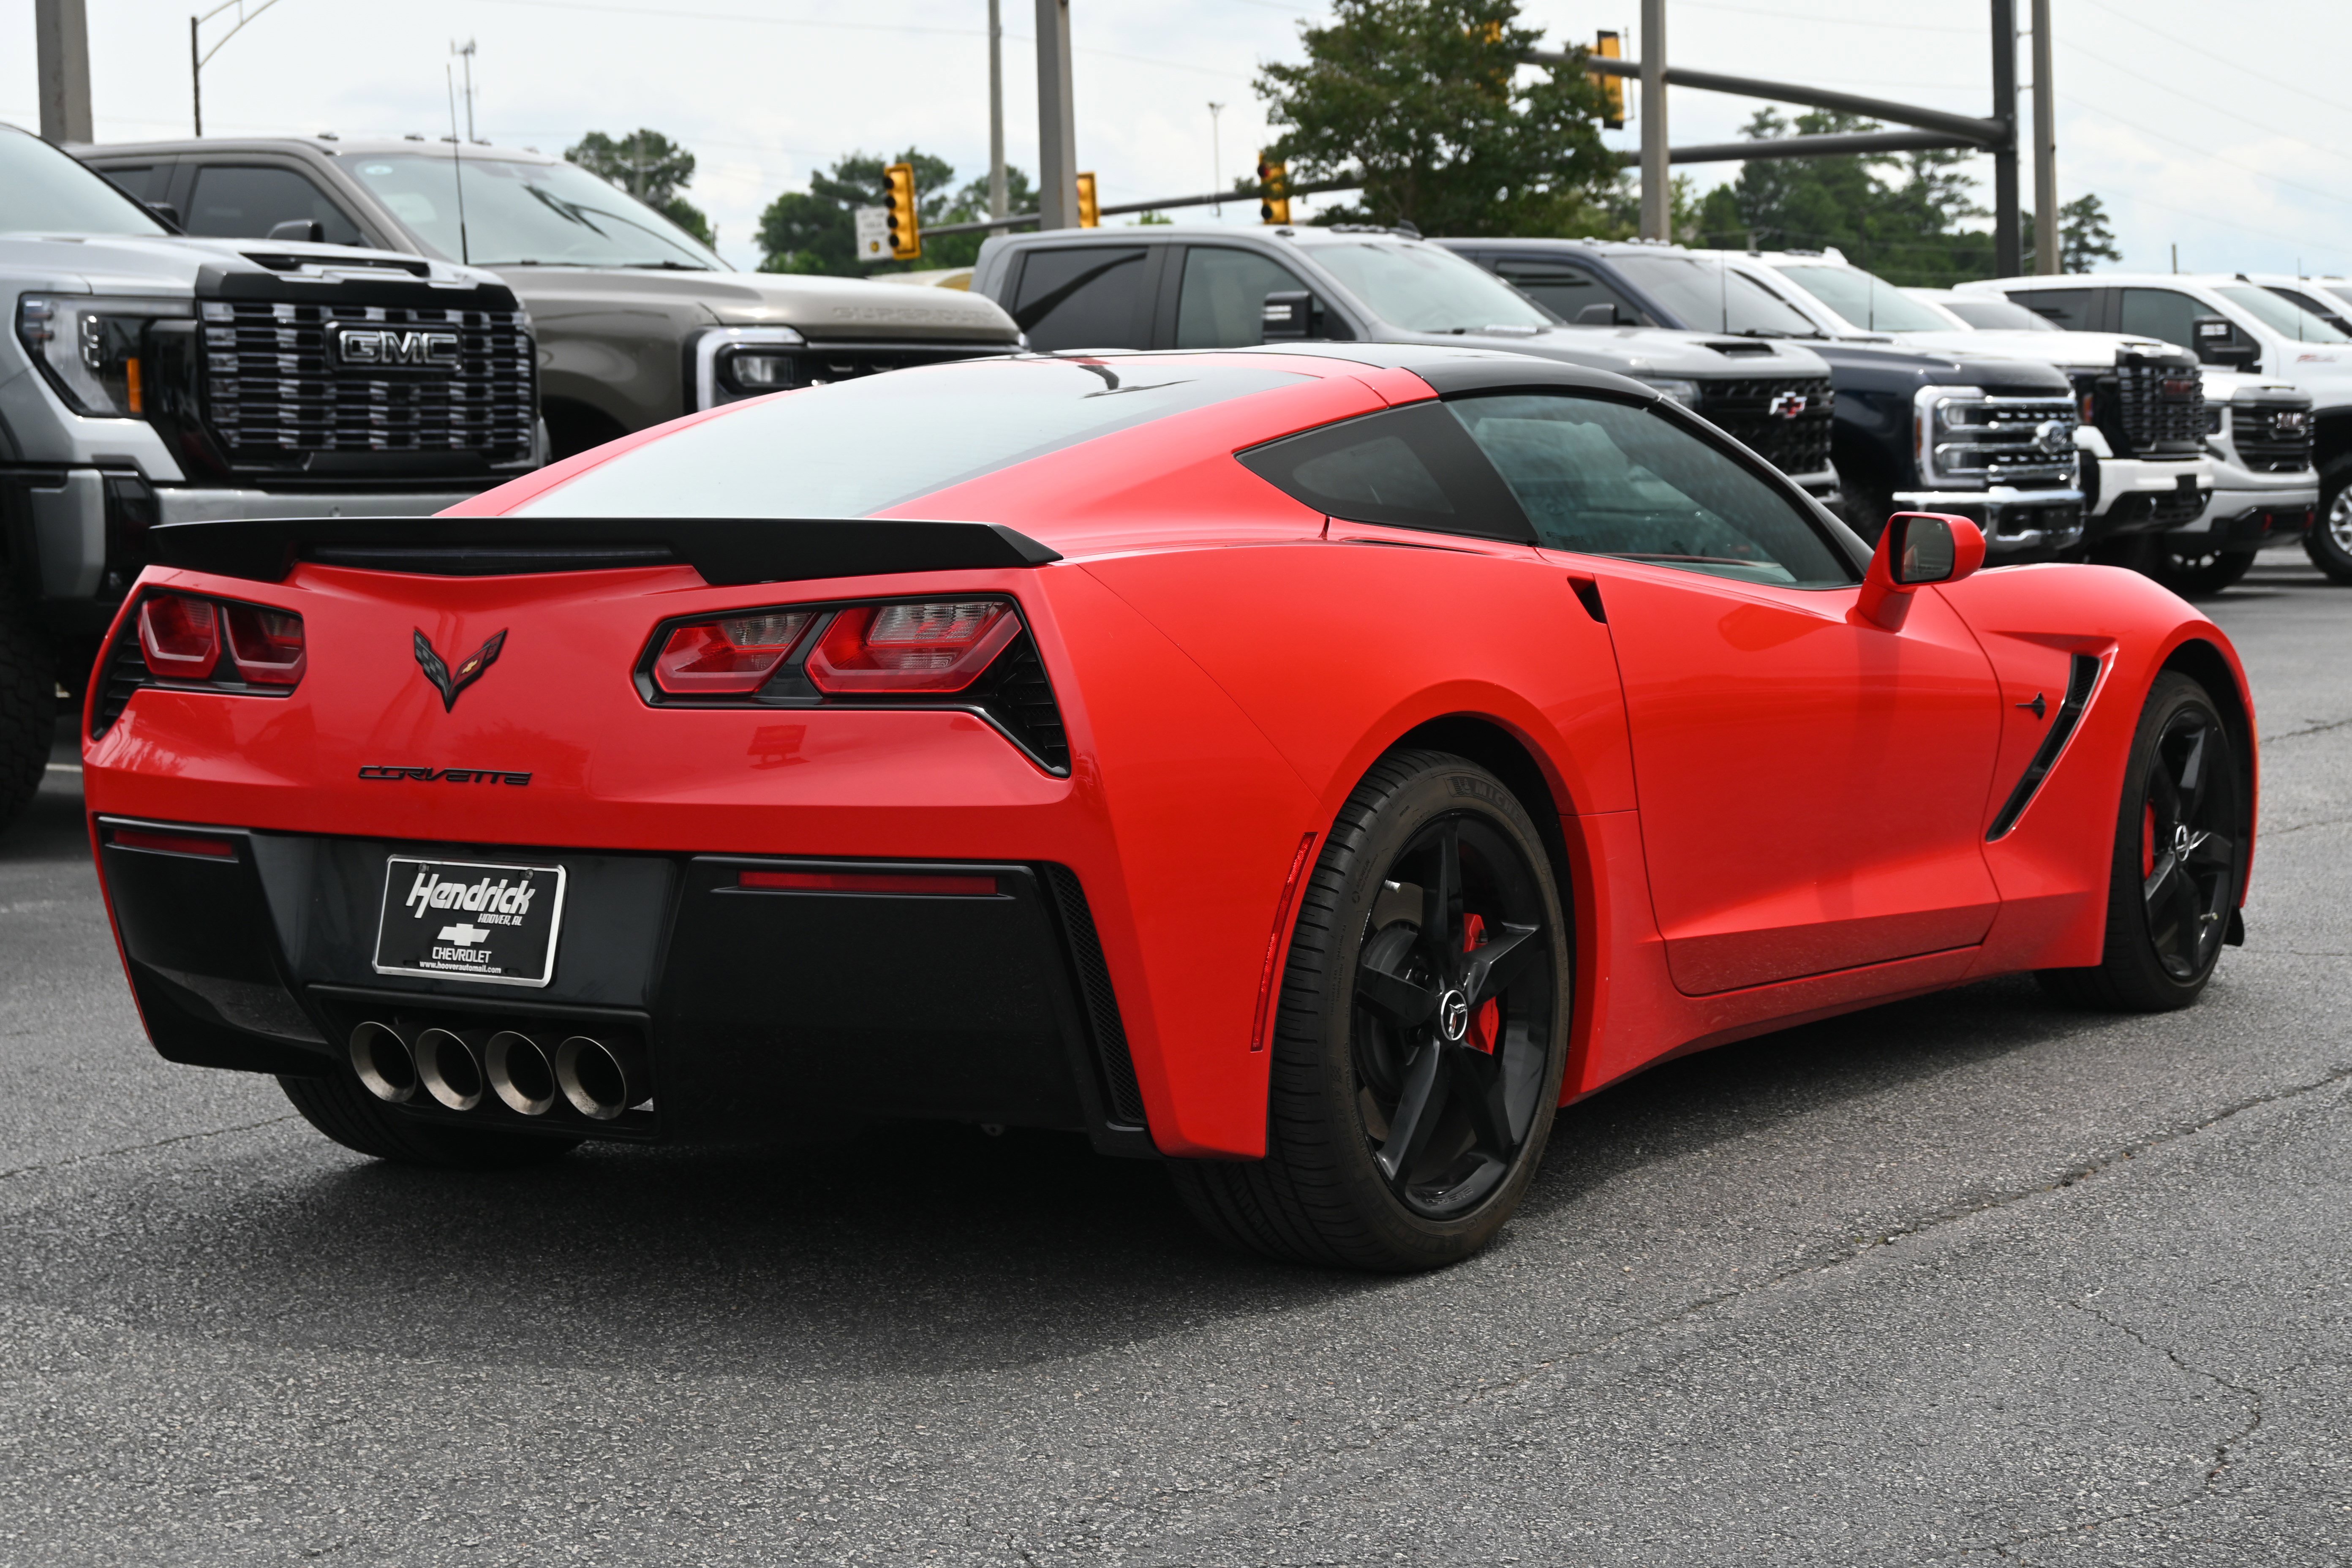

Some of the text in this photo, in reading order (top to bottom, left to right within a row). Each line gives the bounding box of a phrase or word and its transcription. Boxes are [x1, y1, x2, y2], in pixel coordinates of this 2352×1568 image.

[339, 330, 457, 364] GMC
[358, 765, 532, 786] CORVETTE
[406, 873, 535, 918] Hendrick
[477, 913, 523, 926] HOOVER, AL
[432, 947, 492, 963] CHEVROLET
[419, 961, 501, 974] www.hooverautomall.com
